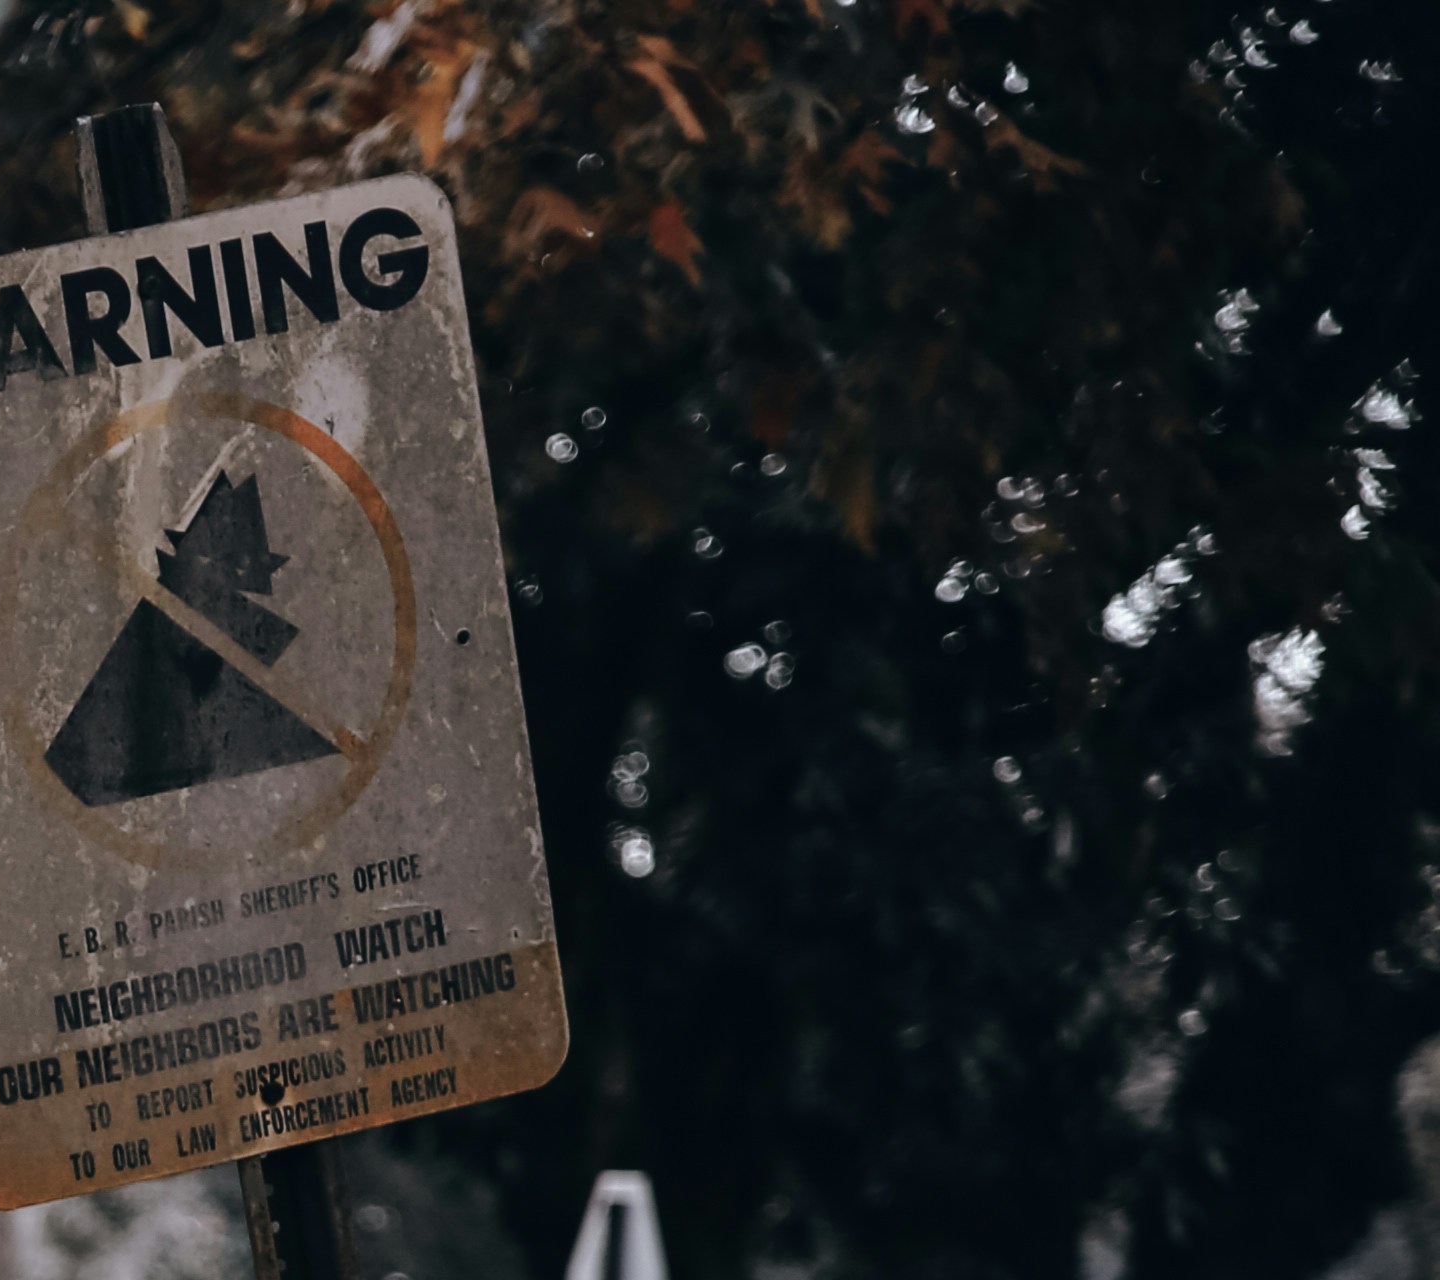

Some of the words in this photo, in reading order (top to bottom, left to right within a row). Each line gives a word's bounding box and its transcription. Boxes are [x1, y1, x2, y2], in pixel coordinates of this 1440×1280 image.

[149, 899, 225, 940] PARISH
[240, 872, 341, 918] SHERIFF'S
[353, 853, 423, 893] OFFICE
[53, 941, 307, 1033] NEIGHBORHOOD
[334, 908, 447, 968] WATCH
[75, 1010, 262, 1089] NEIGHBORS
[277, 994, 340, 1042] ARE
[351, 952, 517, 1025] WATCHING
[68, 1150, 96, 1181] TO
[112, 1138, 152, 1172] OUR
[176, 1123, 217, 1157] LAW
[239, 1086, 370, 1143] ENFORCEMENT
[390, 1066, 457, 1108] AGENCY
[86, 1101, 111, 1132] TO
[136, 1078, 214, 1121] REPORT
[234, 1047, 347, 1099] SUSPICIOUS
[364, 1024, 446, 1069] ACTIVITY
